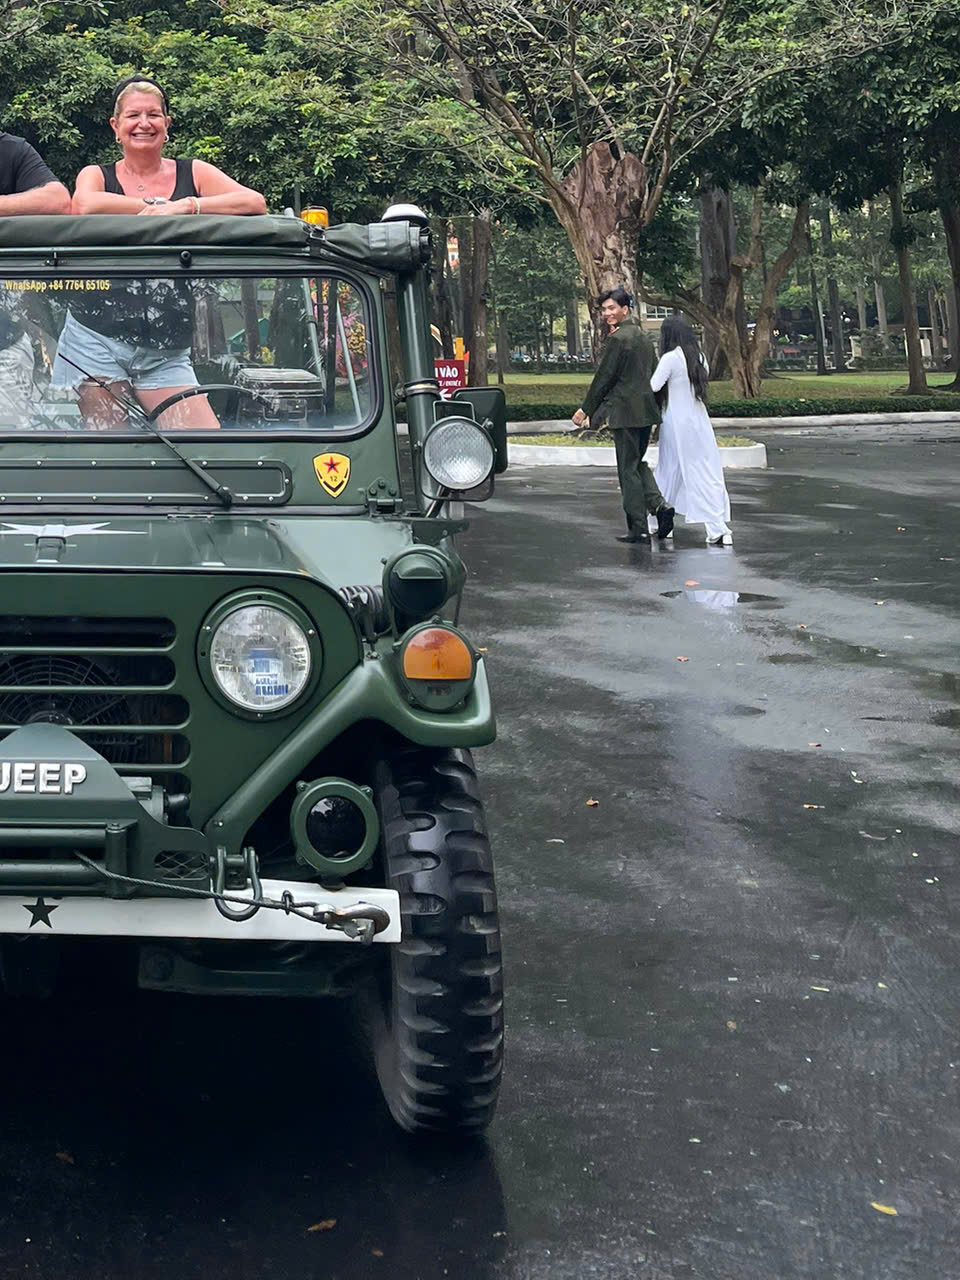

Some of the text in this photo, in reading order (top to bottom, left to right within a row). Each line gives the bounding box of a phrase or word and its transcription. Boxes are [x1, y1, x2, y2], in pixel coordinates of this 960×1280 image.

[5, 280, 110, 293] WhatsApp +84 7764 65105
[439, 365, 459, 378] VÀO
